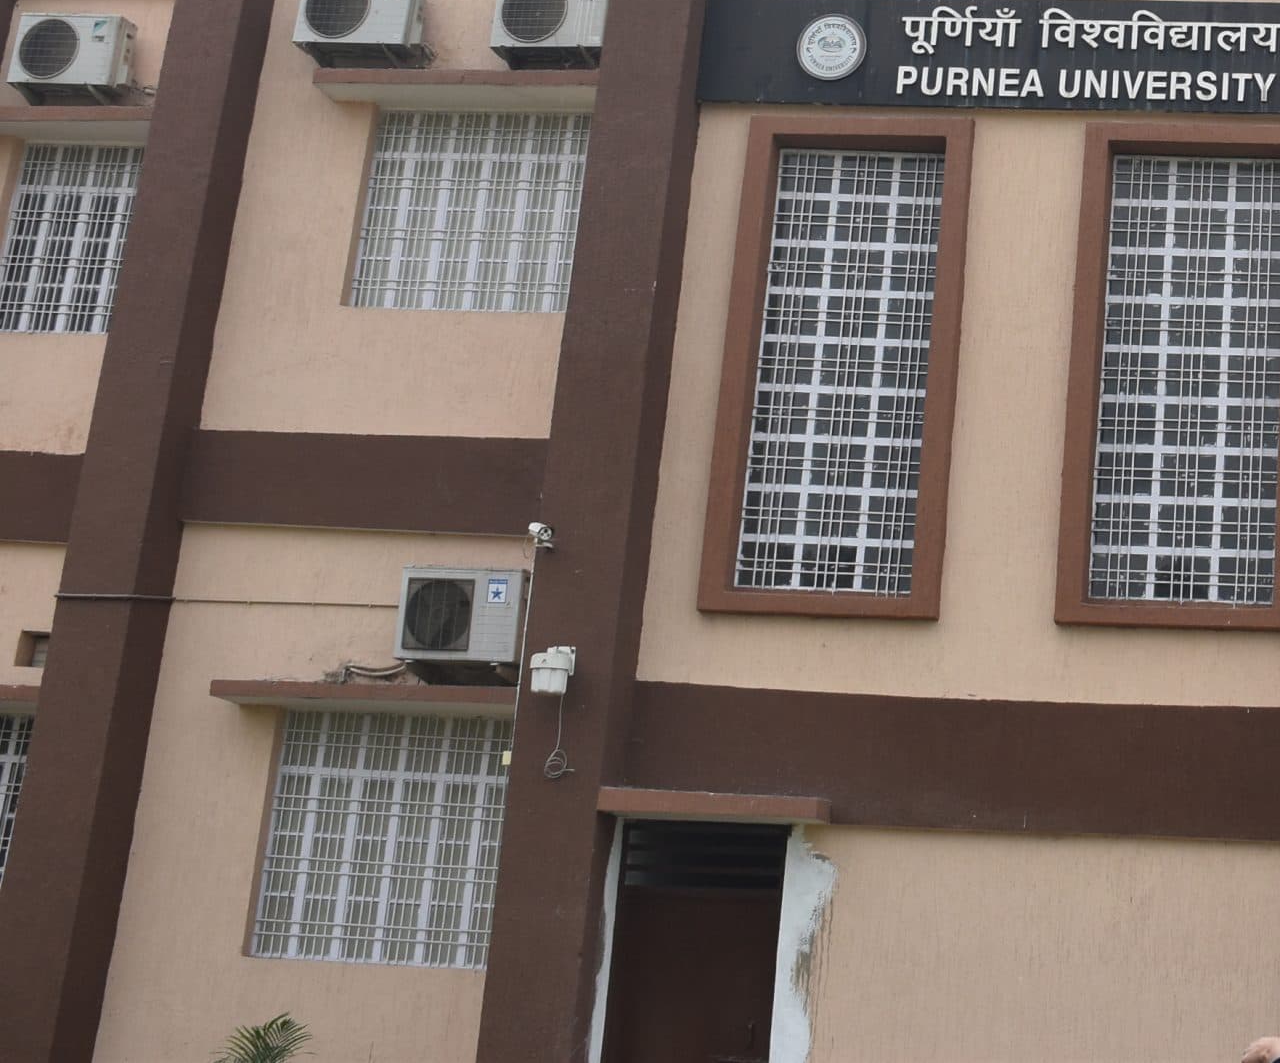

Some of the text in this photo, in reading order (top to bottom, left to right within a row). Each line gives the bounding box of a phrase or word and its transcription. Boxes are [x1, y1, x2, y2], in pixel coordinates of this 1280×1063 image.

[902, 6, 1280, 54] पूर्णियाँ विश्वविद्यालय
[896, 65, 1277, 102] PURNEA UNIVERSITY
